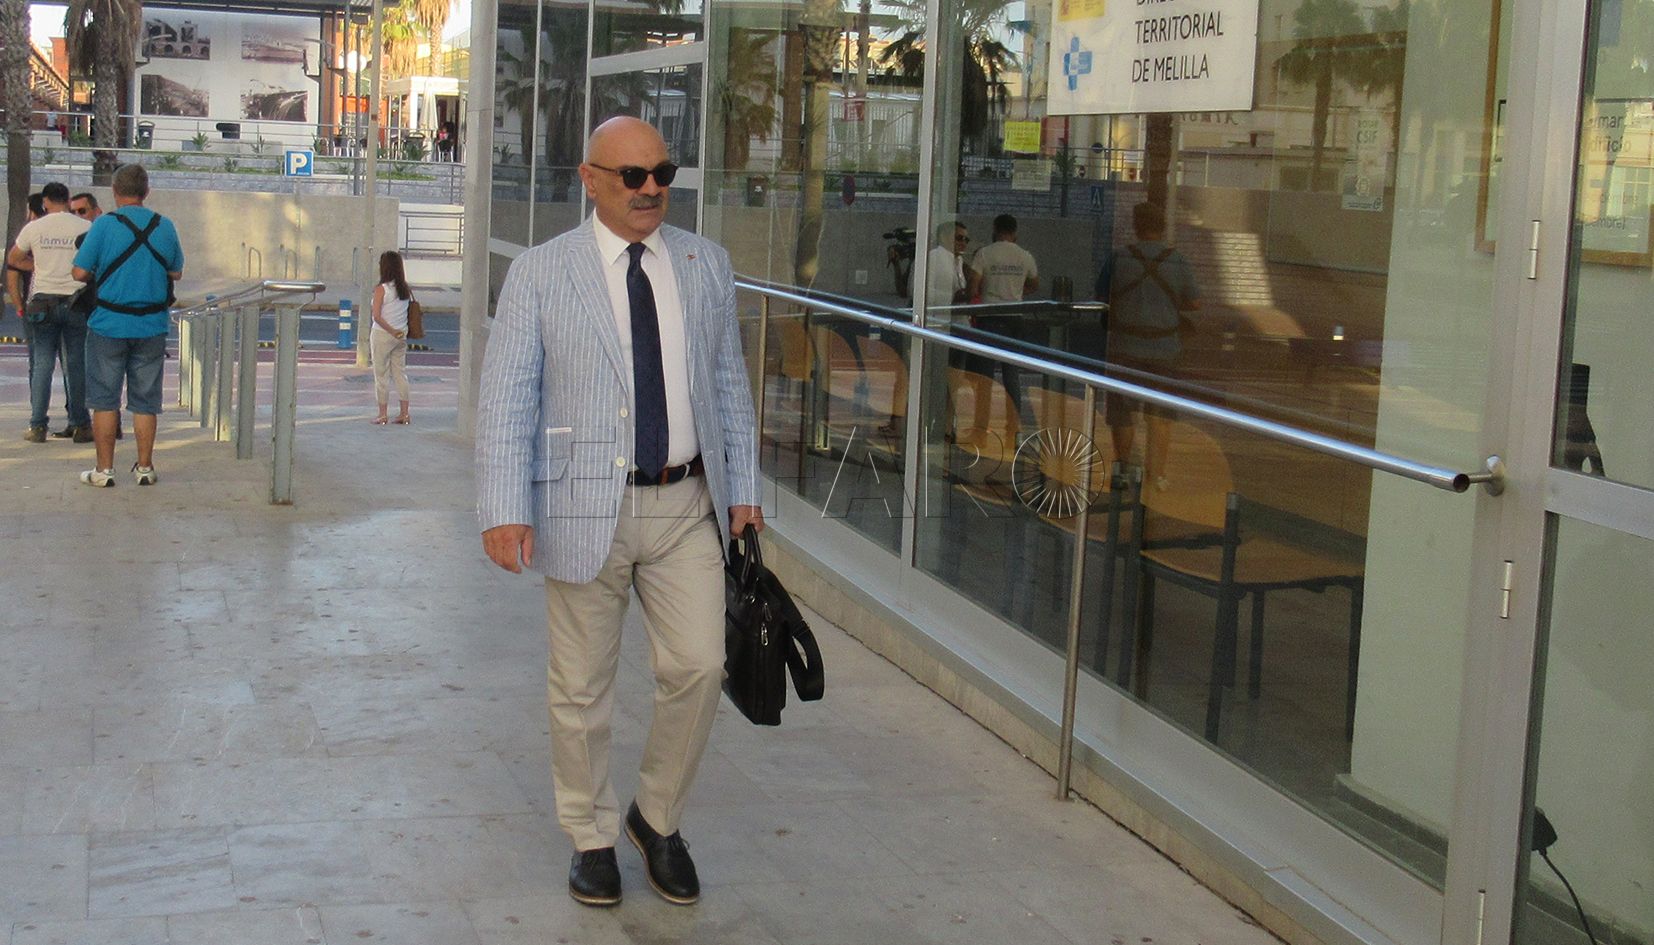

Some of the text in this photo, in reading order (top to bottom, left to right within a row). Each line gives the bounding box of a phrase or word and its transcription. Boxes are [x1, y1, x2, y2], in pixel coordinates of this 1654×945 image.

[1135, 11, 1224, 44] TERRITORIAL
[1131, 53, 1209, 83] DE MELILLA
